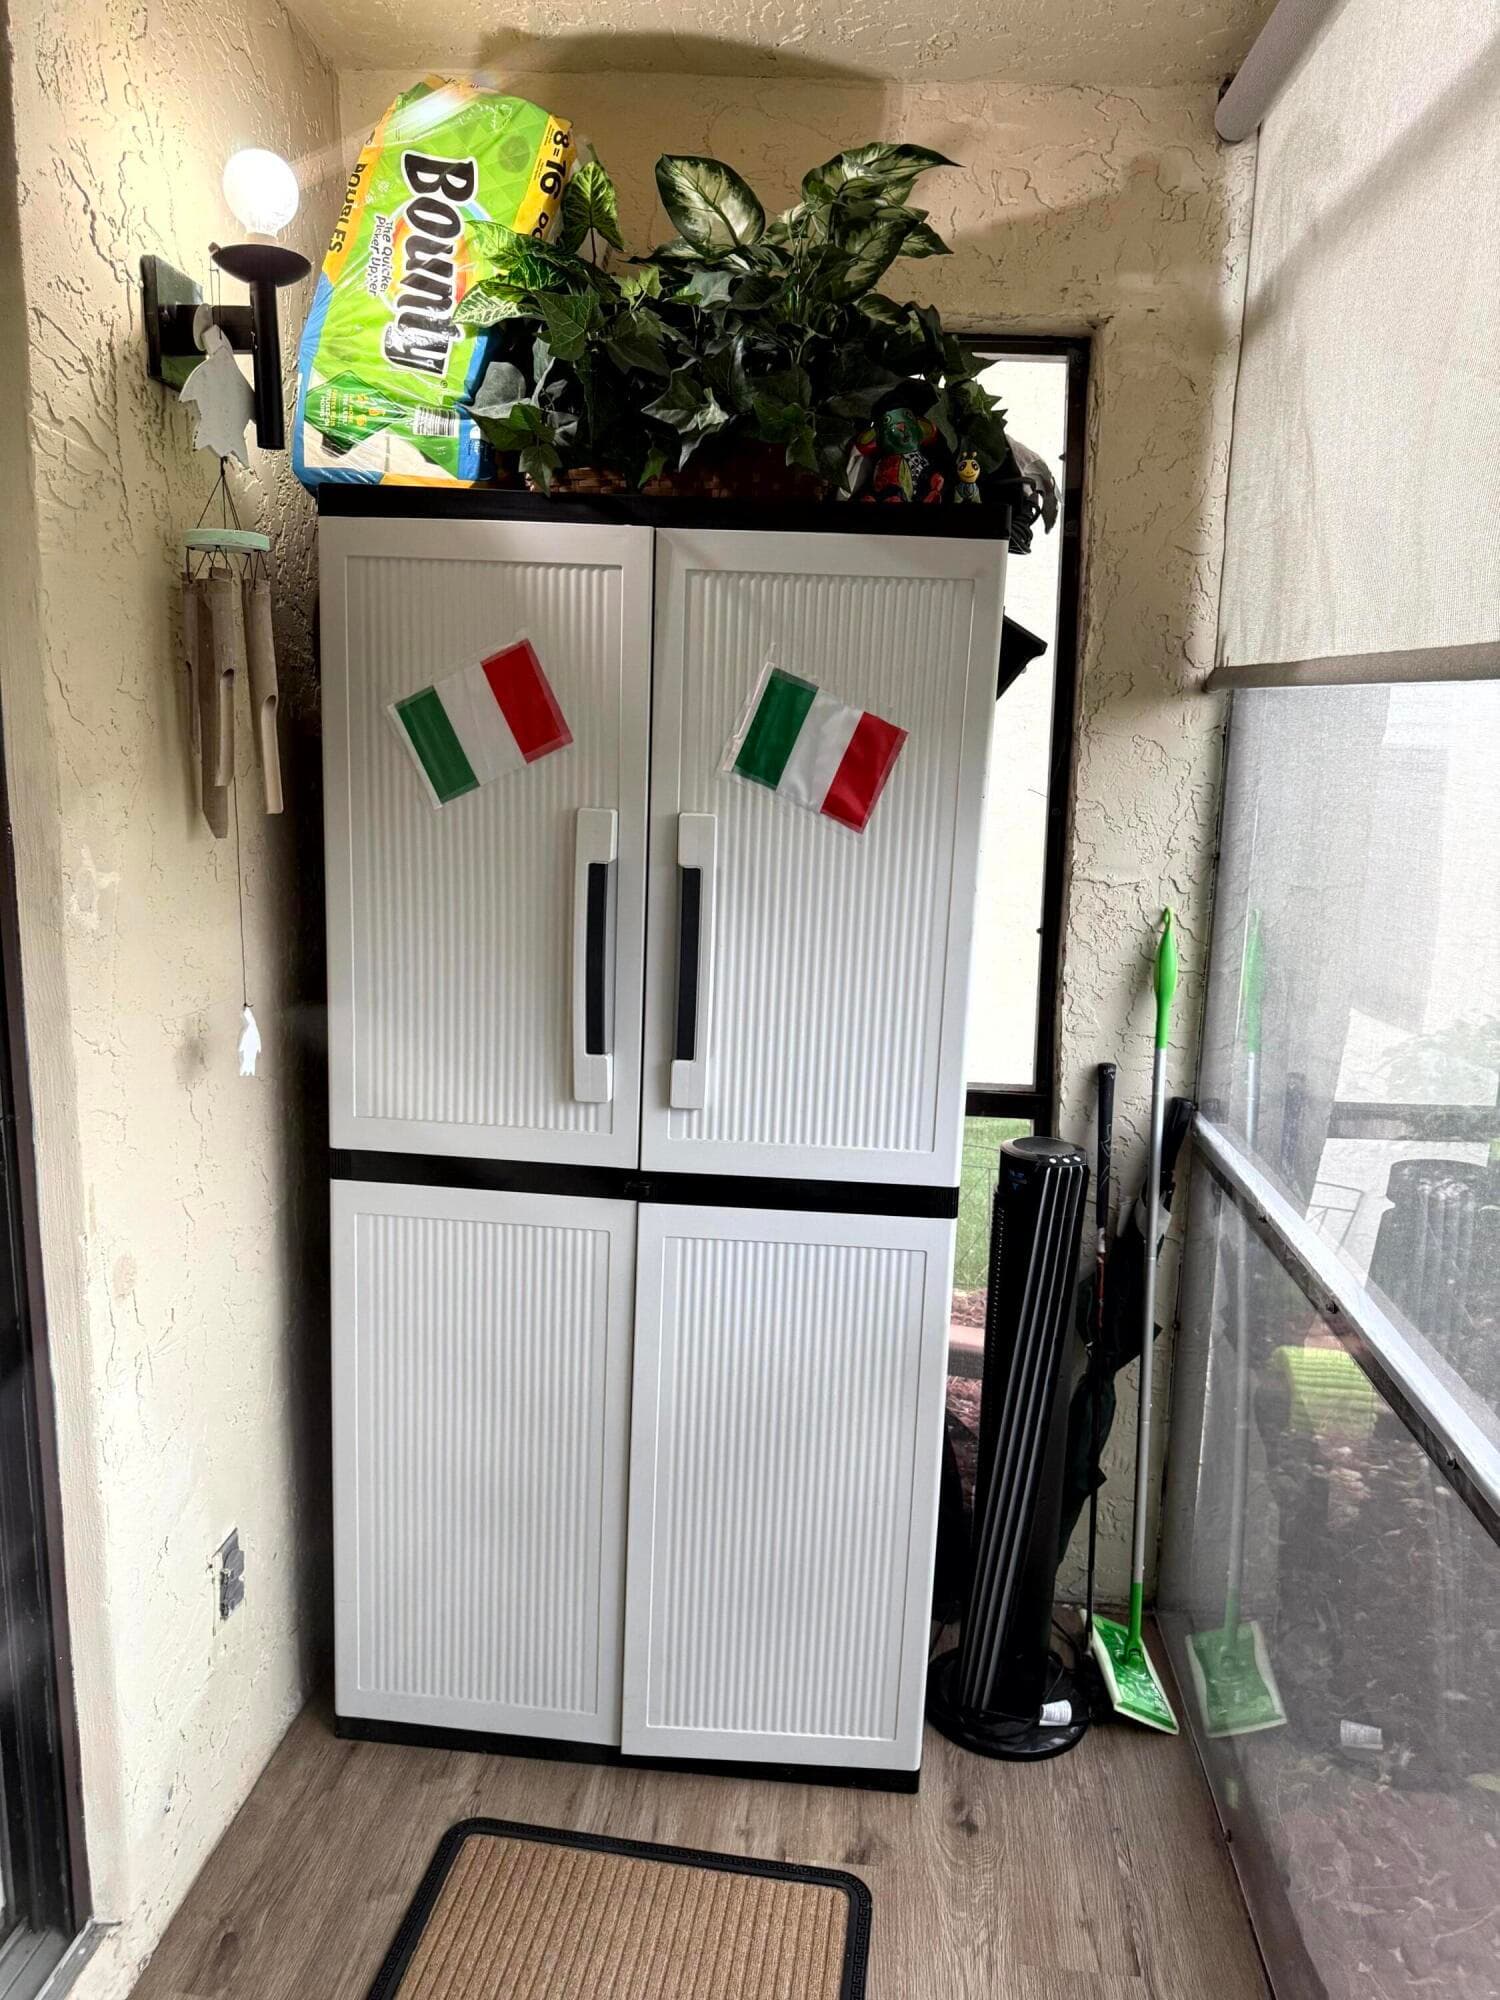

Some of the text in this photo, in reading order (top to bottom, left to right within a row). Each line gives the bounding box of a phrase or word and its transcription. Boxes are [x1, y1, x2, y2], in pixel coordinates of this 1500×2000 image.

[371, 215, 386, 253] Picker
[382, 221, 393, 242] The
[385, 153, 474, 374] Bounty
